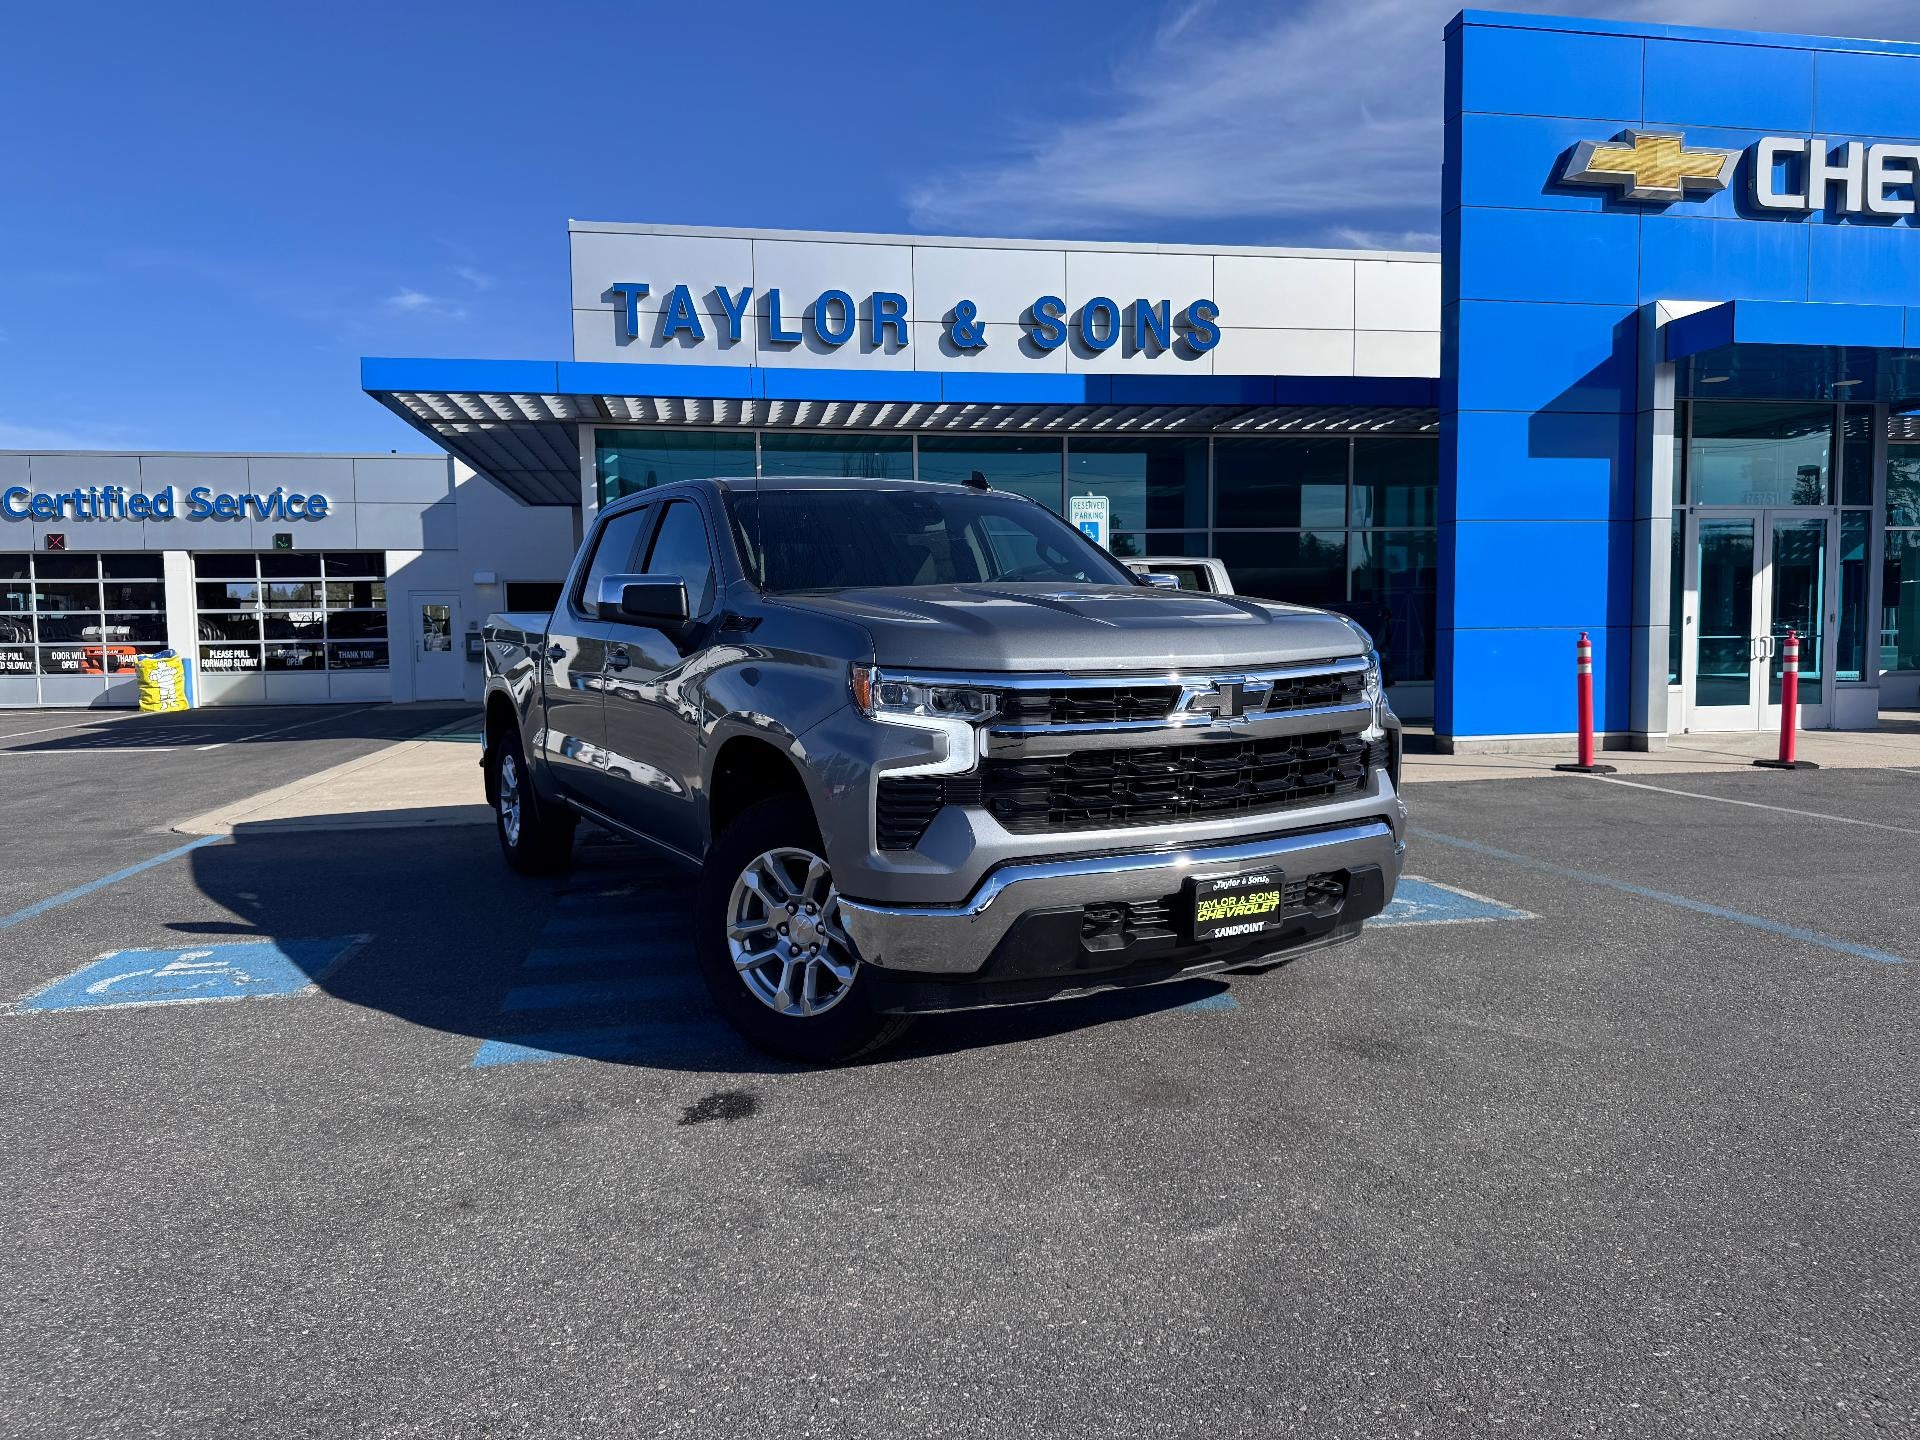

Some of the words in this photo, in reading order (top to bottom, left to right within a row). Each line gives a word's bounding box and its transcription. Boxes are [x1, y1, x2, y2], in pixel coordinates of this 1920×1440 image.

[1757, 136, 1920, 214] CHE
[612, 282, 909, 346] TAYLOR
[951, 299, 987, 348] &
[1031, 295, 1221, 352] SONS
[2, 486, 175, 518] Certified
[190, 486, 328, 518] Service
[1073, 501, 1105, 510] RESERVED
[1075, 511, 1104, 519] PARKING
[8, 652, 24, 660] PULL
[52, 652, 70, 660] DOOR
[72, 651, 87, 660] WILL
[209, 650, 233, 658] PLEASE
[234, 650, 250, 658] PULL
[6, 661, 33, 670] SLOWLY
[62, 660, 78, 669] OPEN
[202, 659, 232, 667] FORWARD
[233, 658, 258, 667] SLOWLY
[1217, 879, 1240, 890] Taylor
[1247, 876, 1267, 885] Sons
[1198, 896, 1237, 911] TAYLOR
[1239, 895, 1247, 905] &
[1249, 890, 1280, 902] SONS
[1197, 902, 1279, 921] CHEVROLET
[1215, 921, 1265, 938] SANDPOINT
